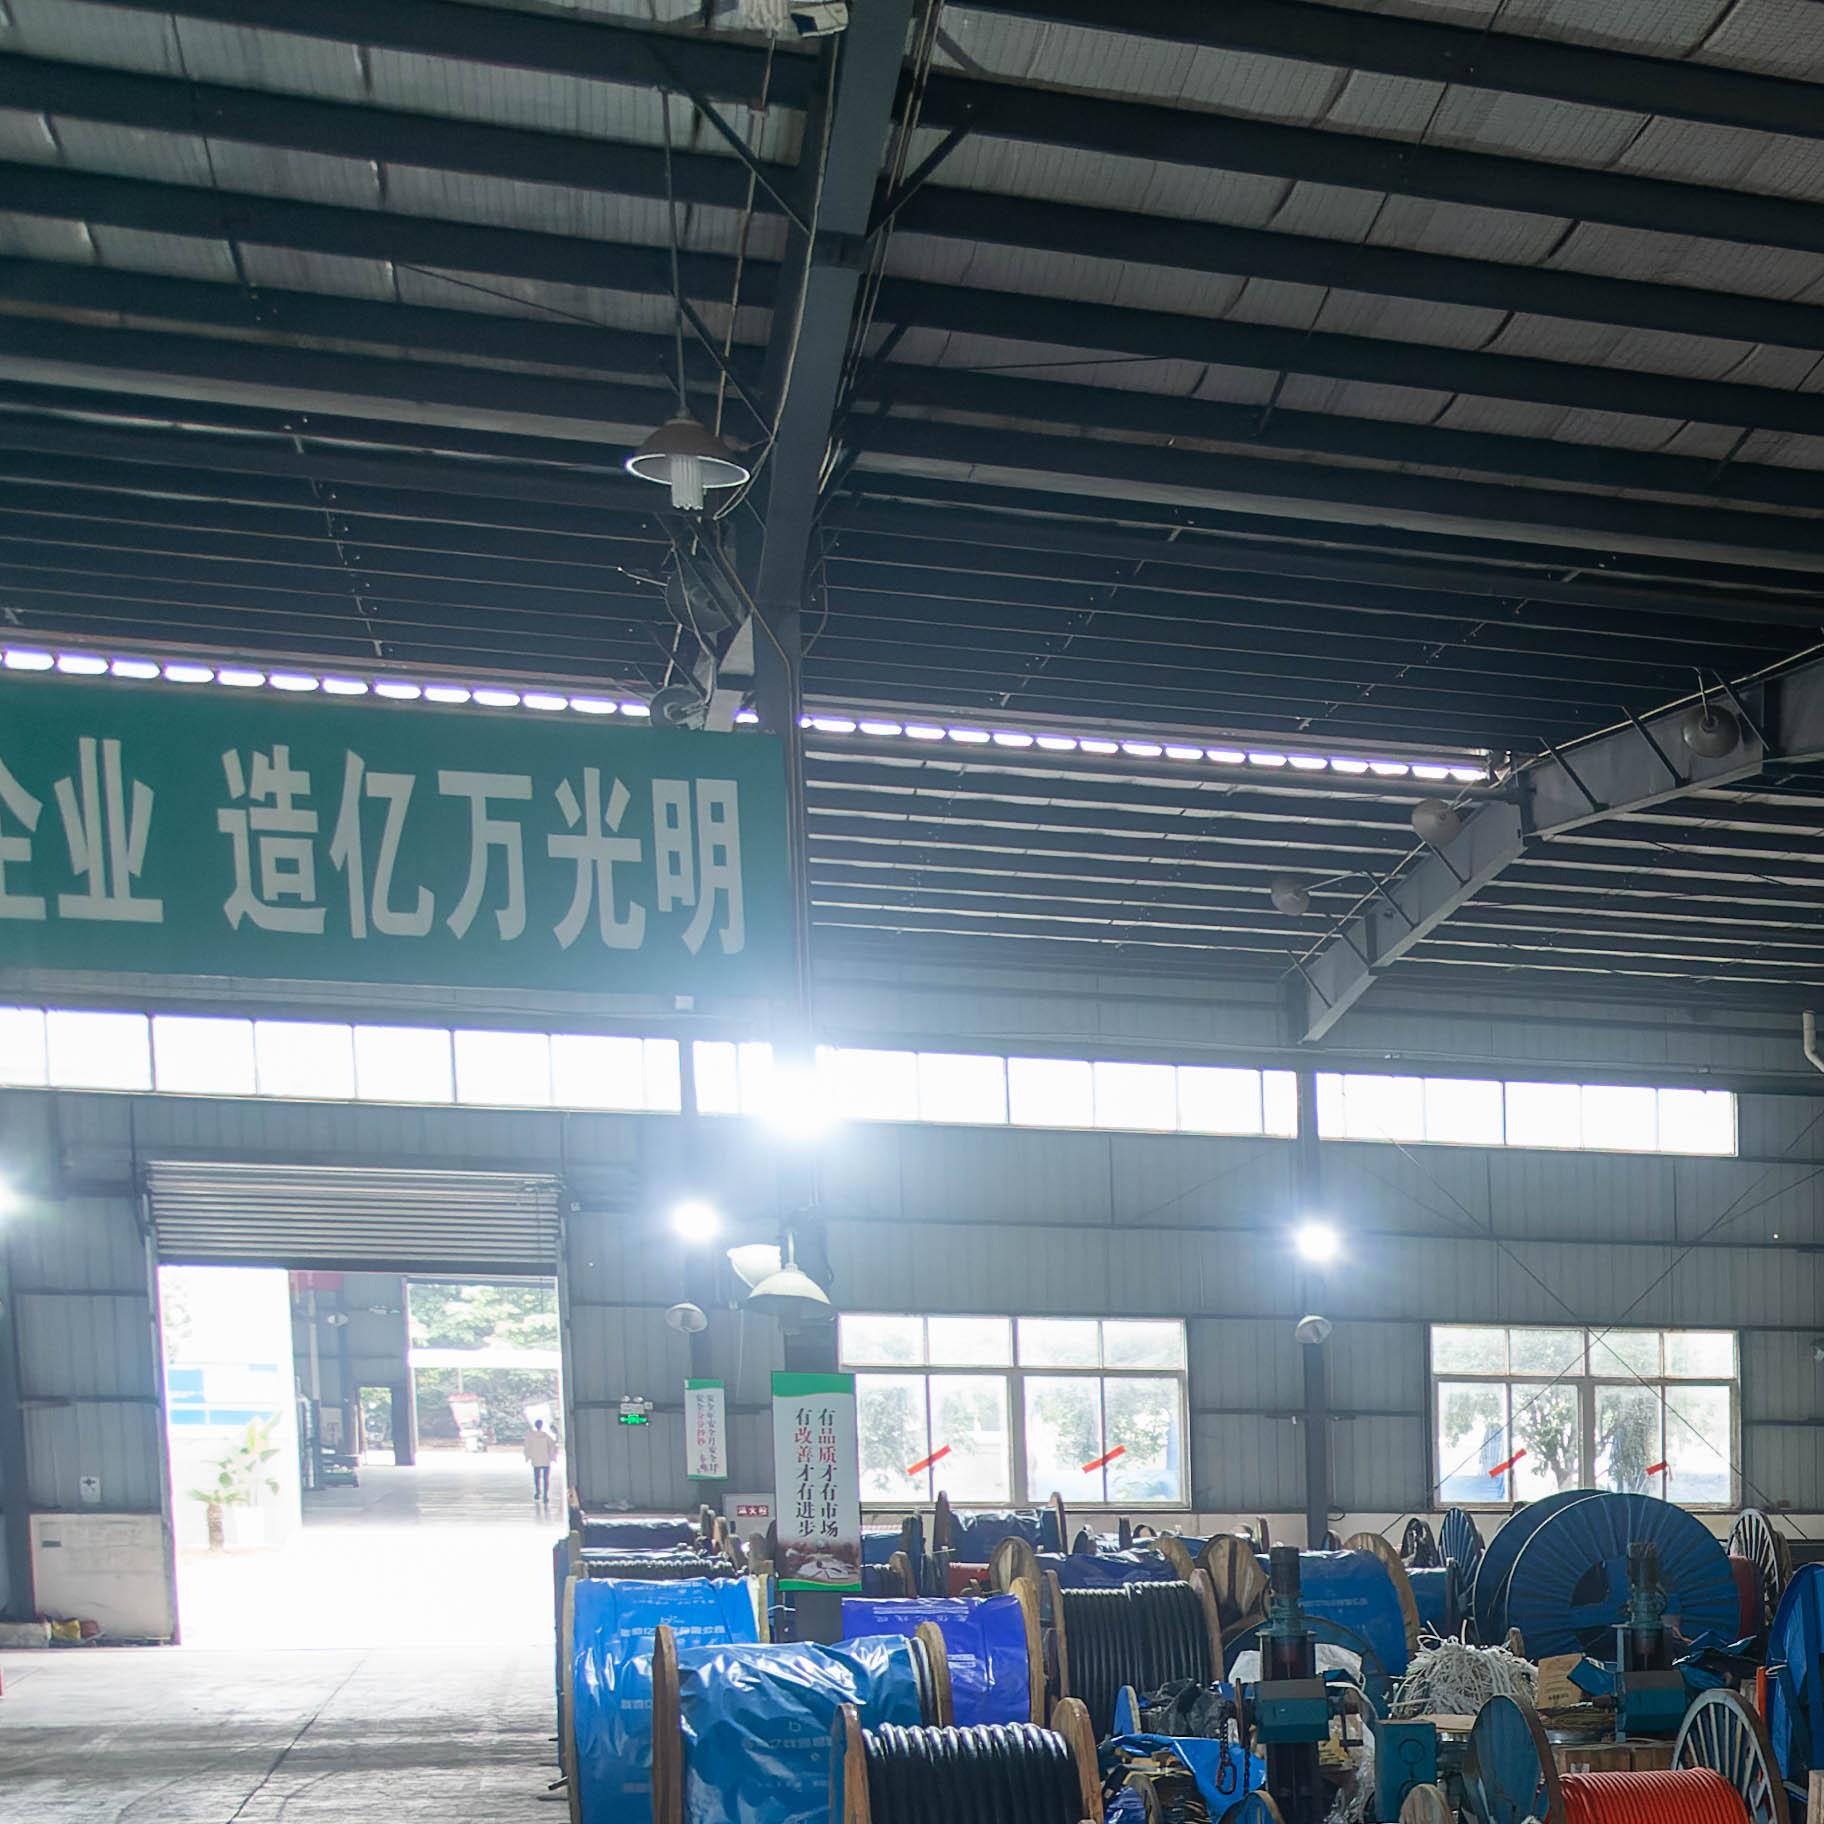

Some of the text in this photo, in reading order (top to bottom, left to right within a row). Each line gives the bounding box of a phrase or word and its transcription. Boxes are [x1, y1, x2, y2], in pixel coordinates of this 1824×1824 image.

[217, 744, 746, 957] 造亿万光明
[795, 1408, 815, 1538] 有改善才有进步
[818, 1408, 838, 1538] 有品质才有市场
